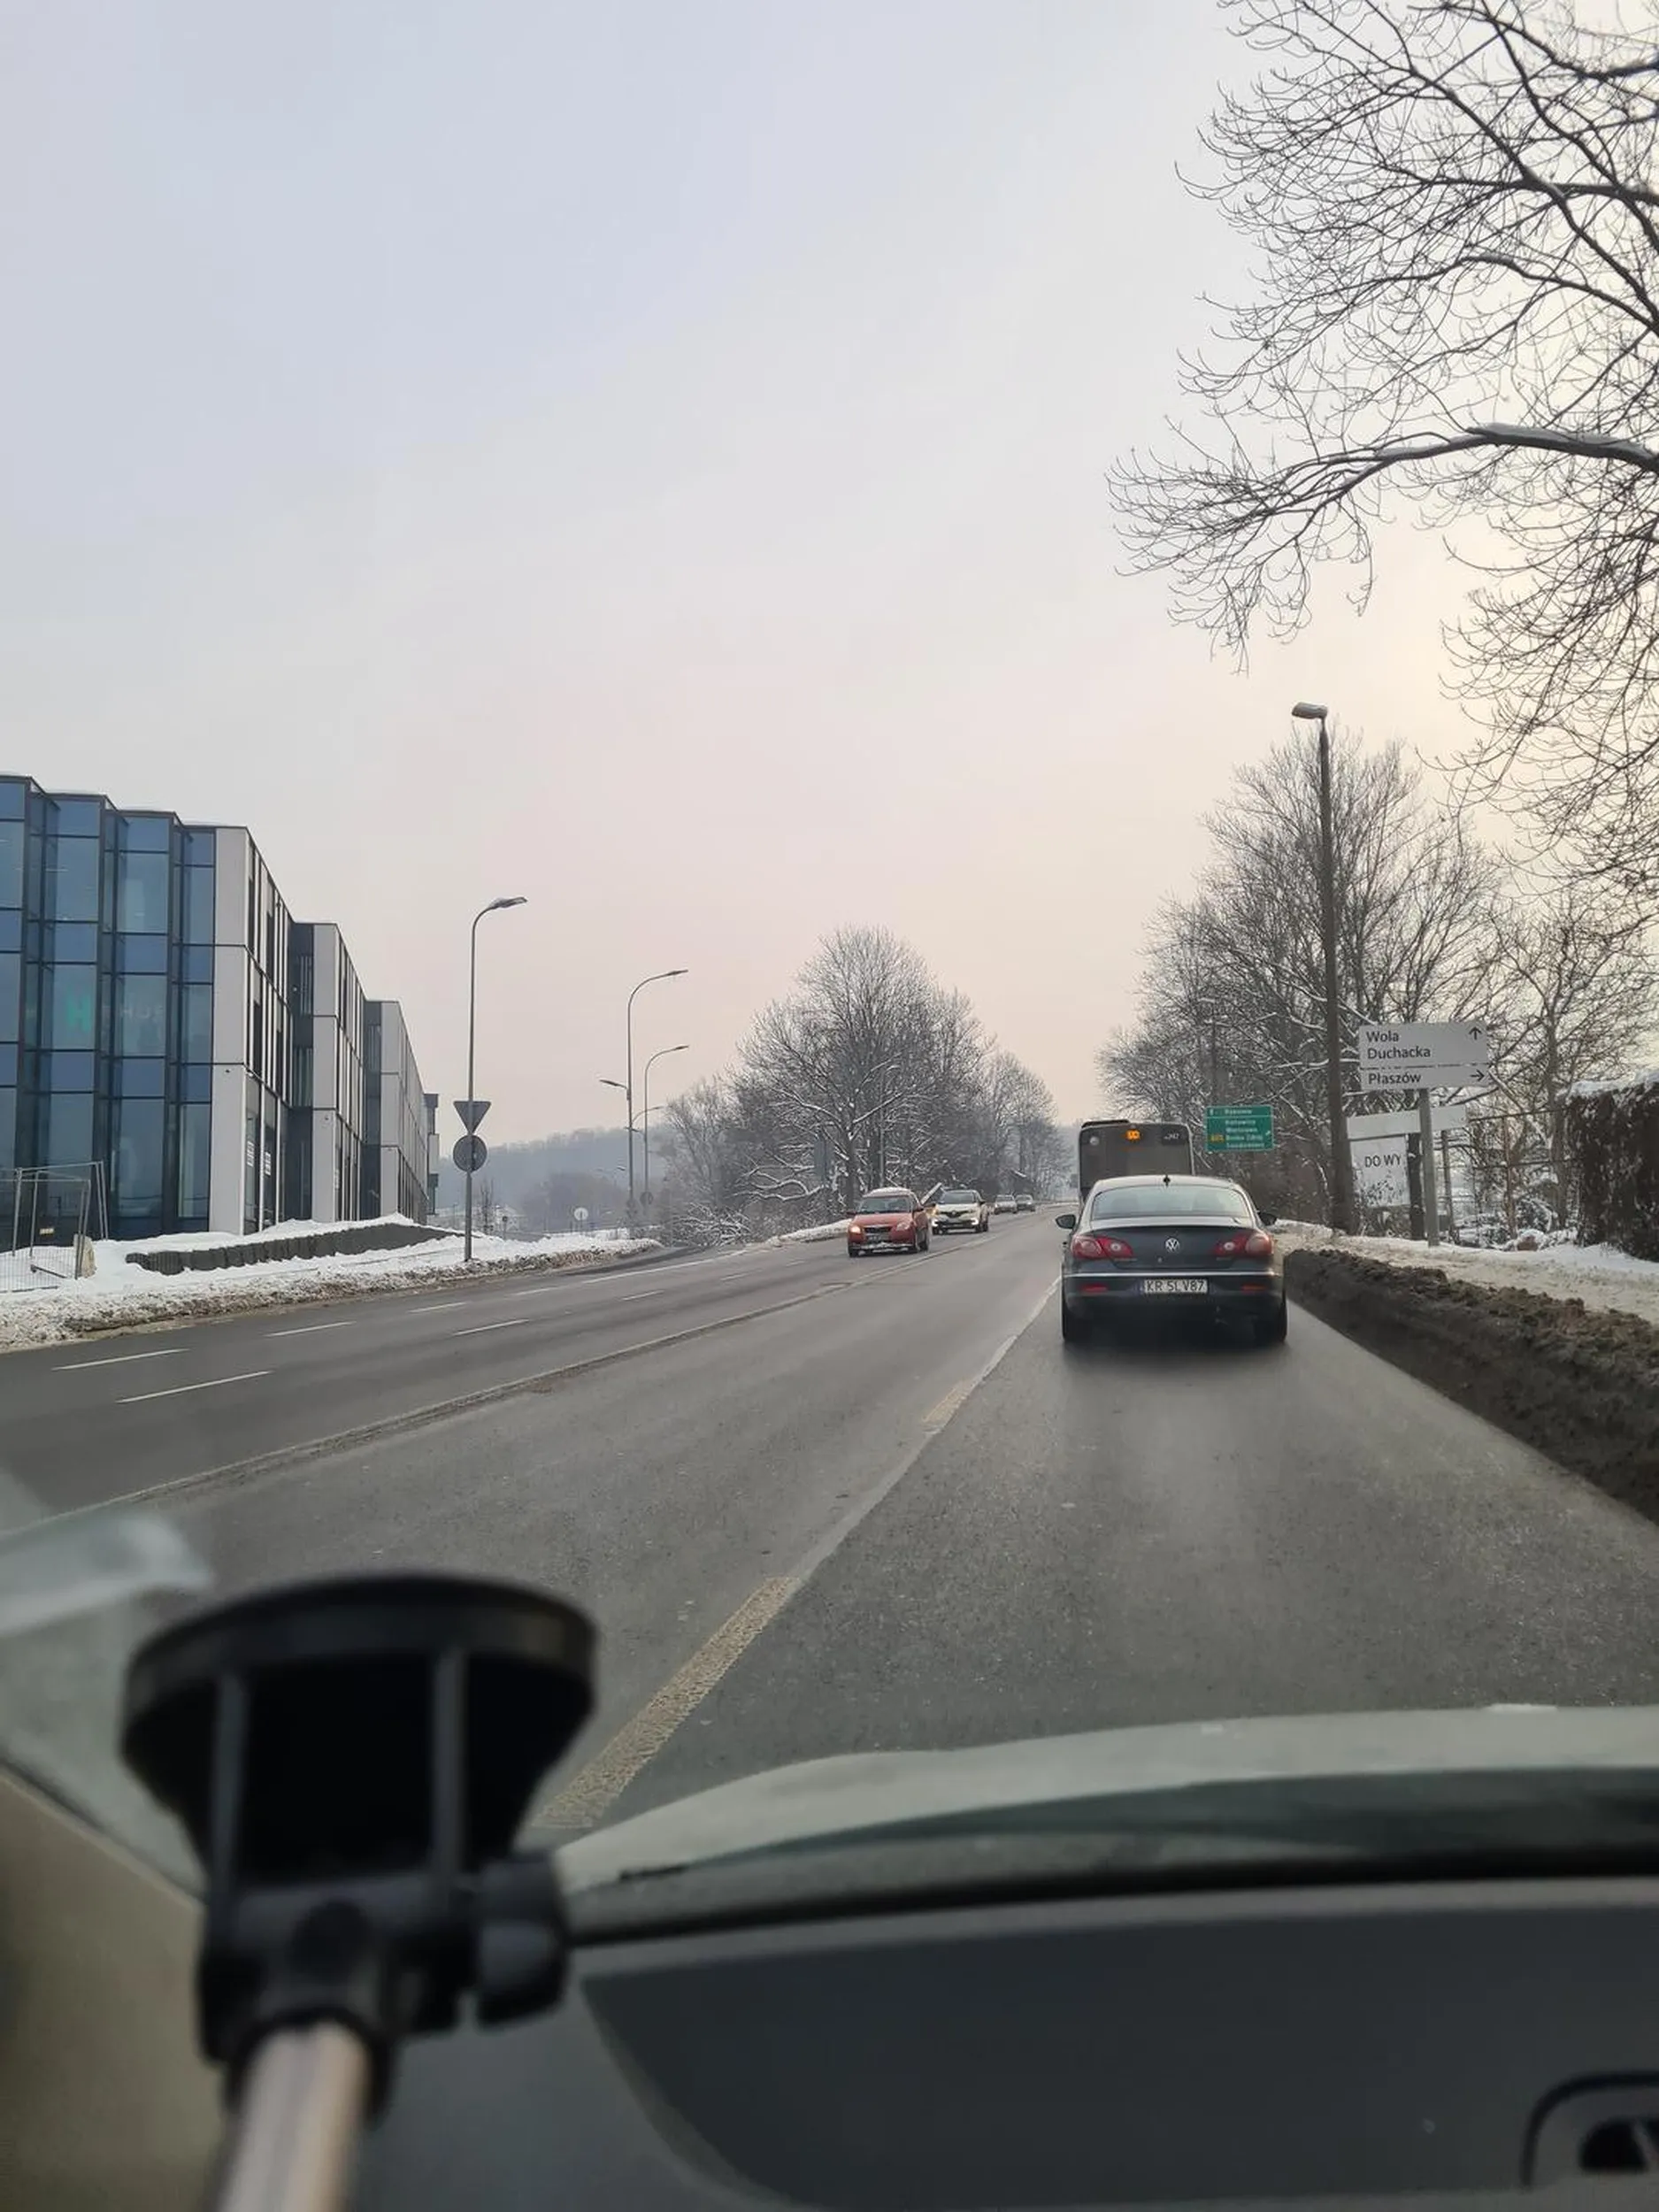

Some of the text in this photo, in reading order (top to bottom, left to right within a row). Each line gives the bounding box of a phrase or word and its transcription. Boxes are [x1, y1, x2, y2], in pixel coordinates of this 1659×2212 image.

[1366, 1030, 1399, 1042] Wola
[1367, 1044, 1431, 1059] Duchacka
[1368, 1071, 1421, 1085] Płaszów
[1364, 1155, 1381, 1168] DO
[1147, 1280, 1163, 1292] KR
